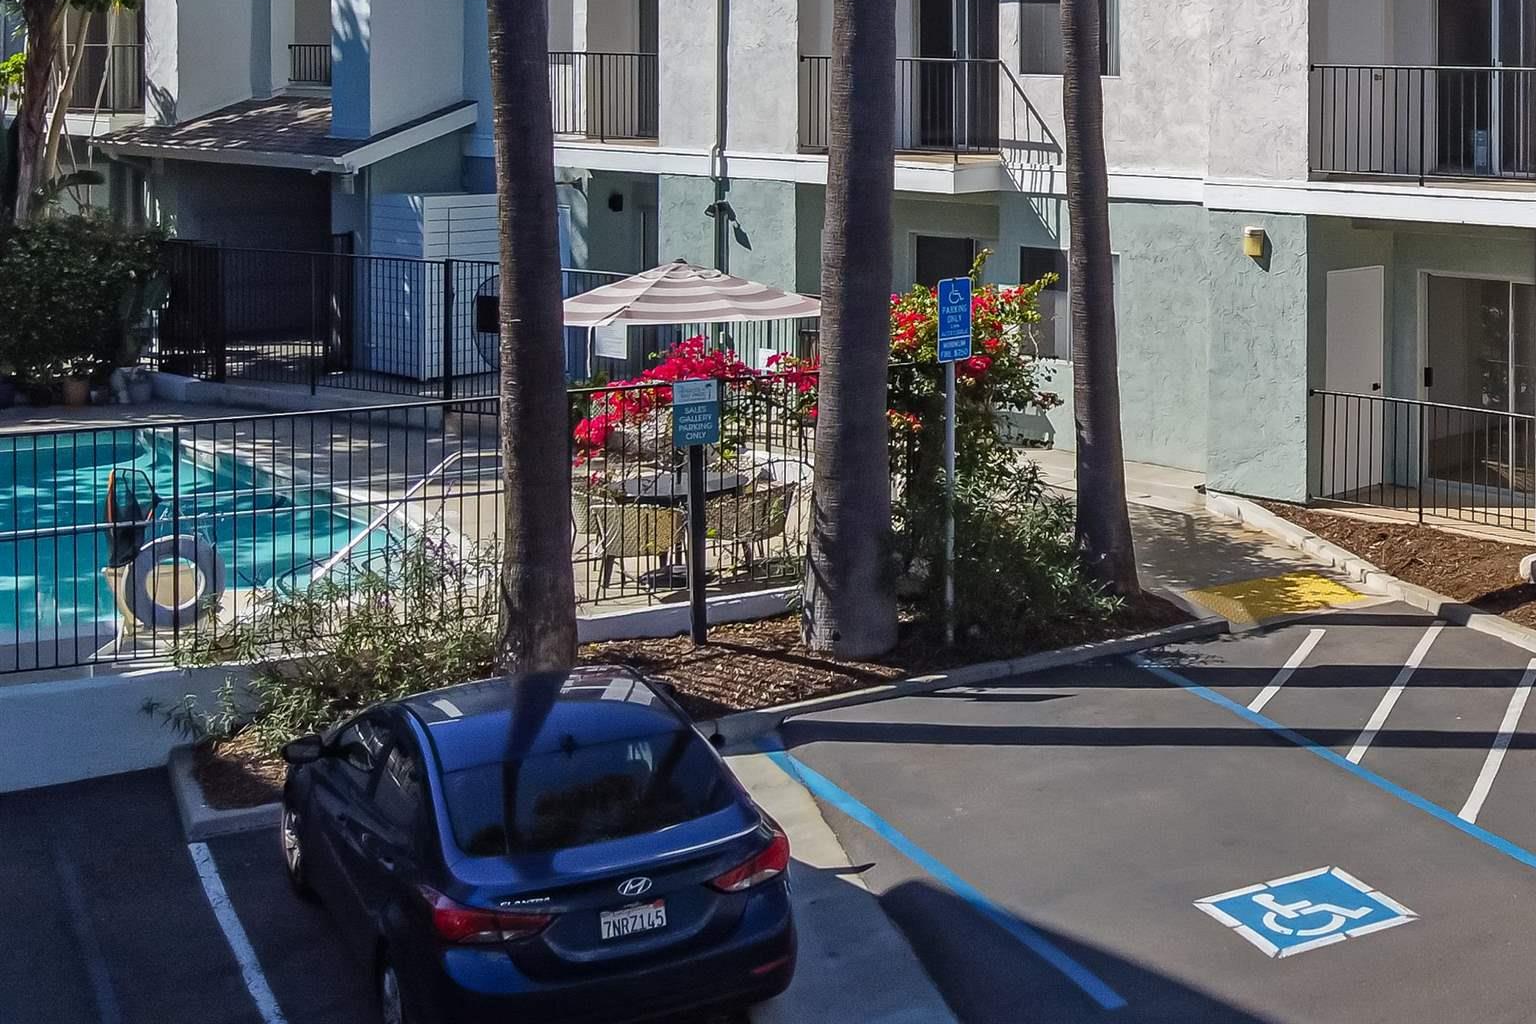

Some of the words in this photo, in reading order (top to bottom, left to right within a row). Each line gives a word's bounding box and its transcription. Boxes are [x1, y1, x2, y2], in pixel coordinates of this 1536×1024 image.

[942, 304, 968, 315] PARKING
[684, 406, 707, 415] SALES
[679, 414, 712, 424] GALLERY
[679, 423, 713, 432] PARKING
[685, 432, 707, 440] ONLY
[603, 909, 665, 937] 7NRZ145
